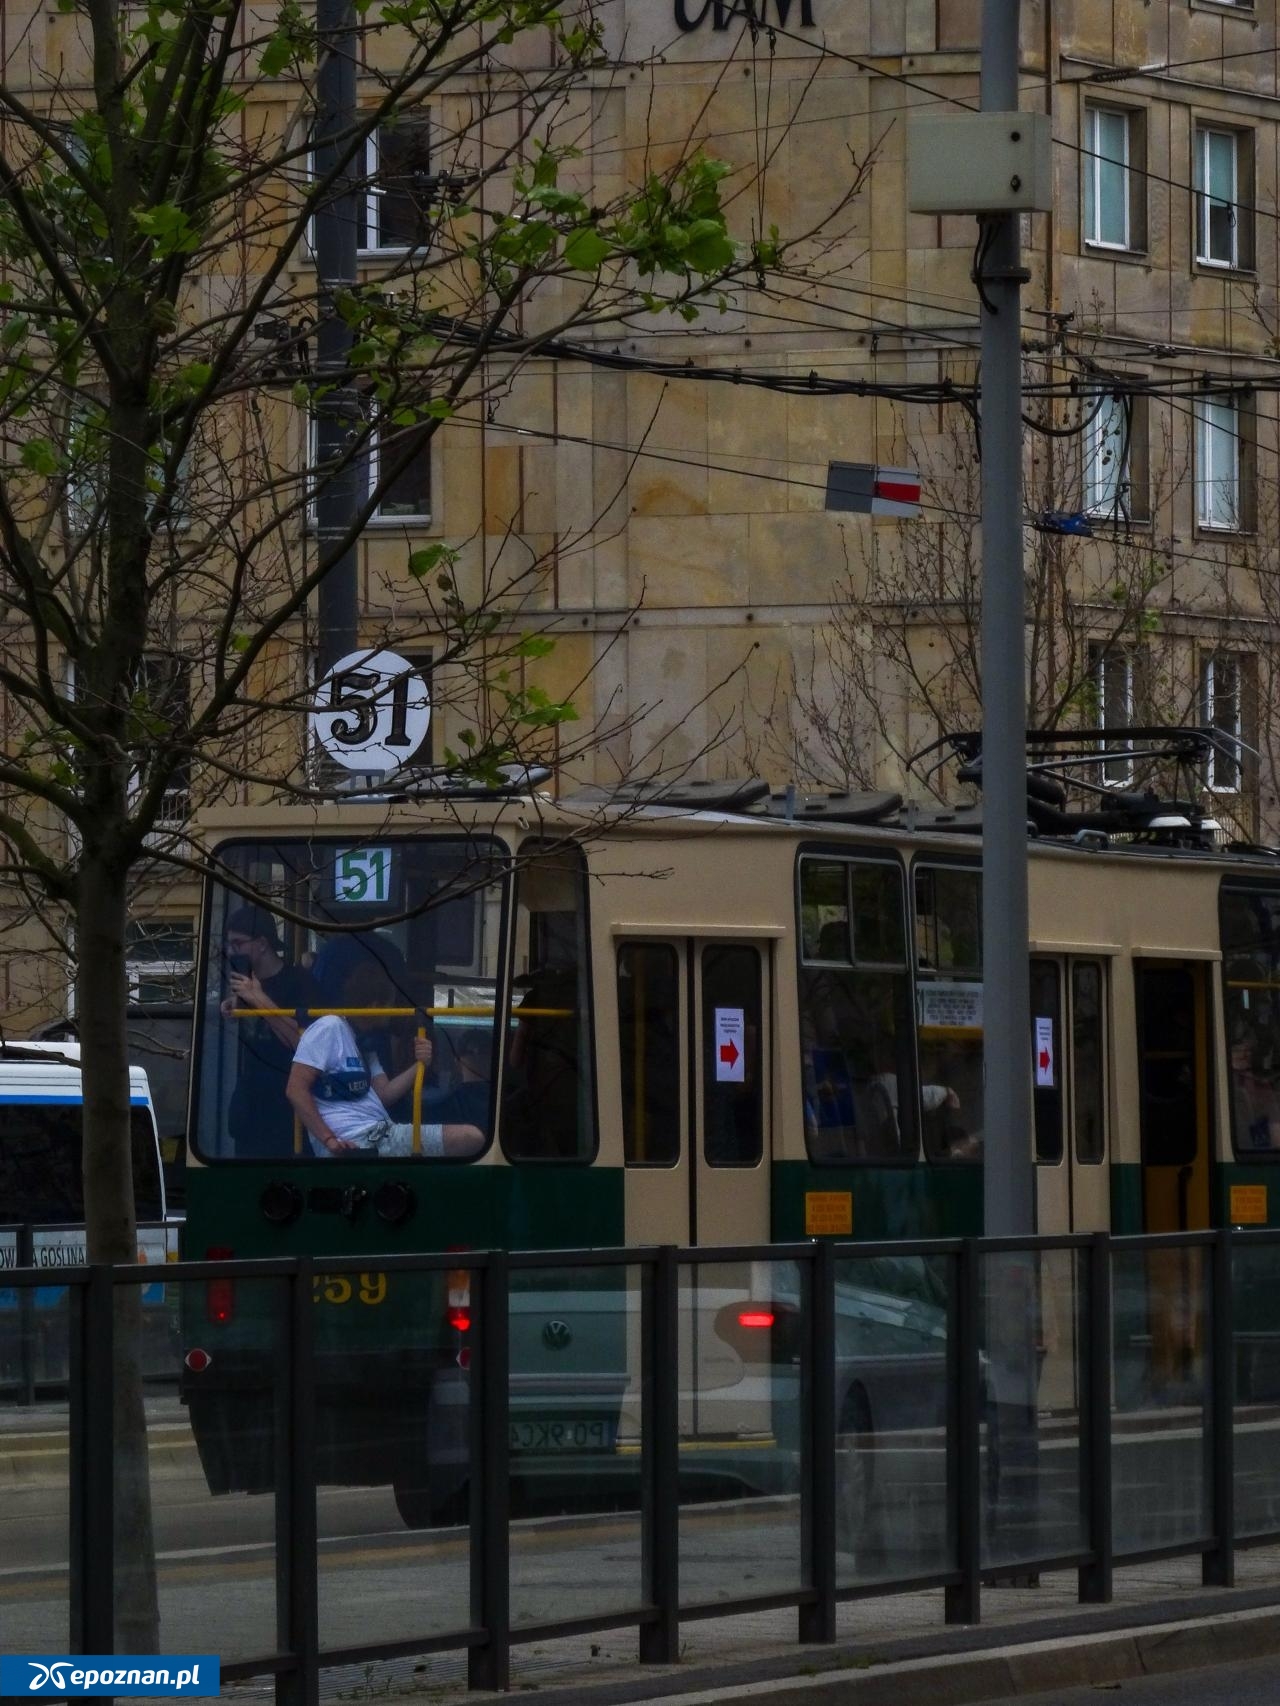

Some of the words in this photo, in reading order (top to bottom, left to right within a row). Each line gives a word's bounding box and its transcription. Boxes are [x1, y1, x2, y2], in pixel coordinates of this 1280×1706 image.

[331, 671, 412, 746] 51
[341, 850, 384, 900] 51
[41, 1239, 85, 1267] GOŚLINA
